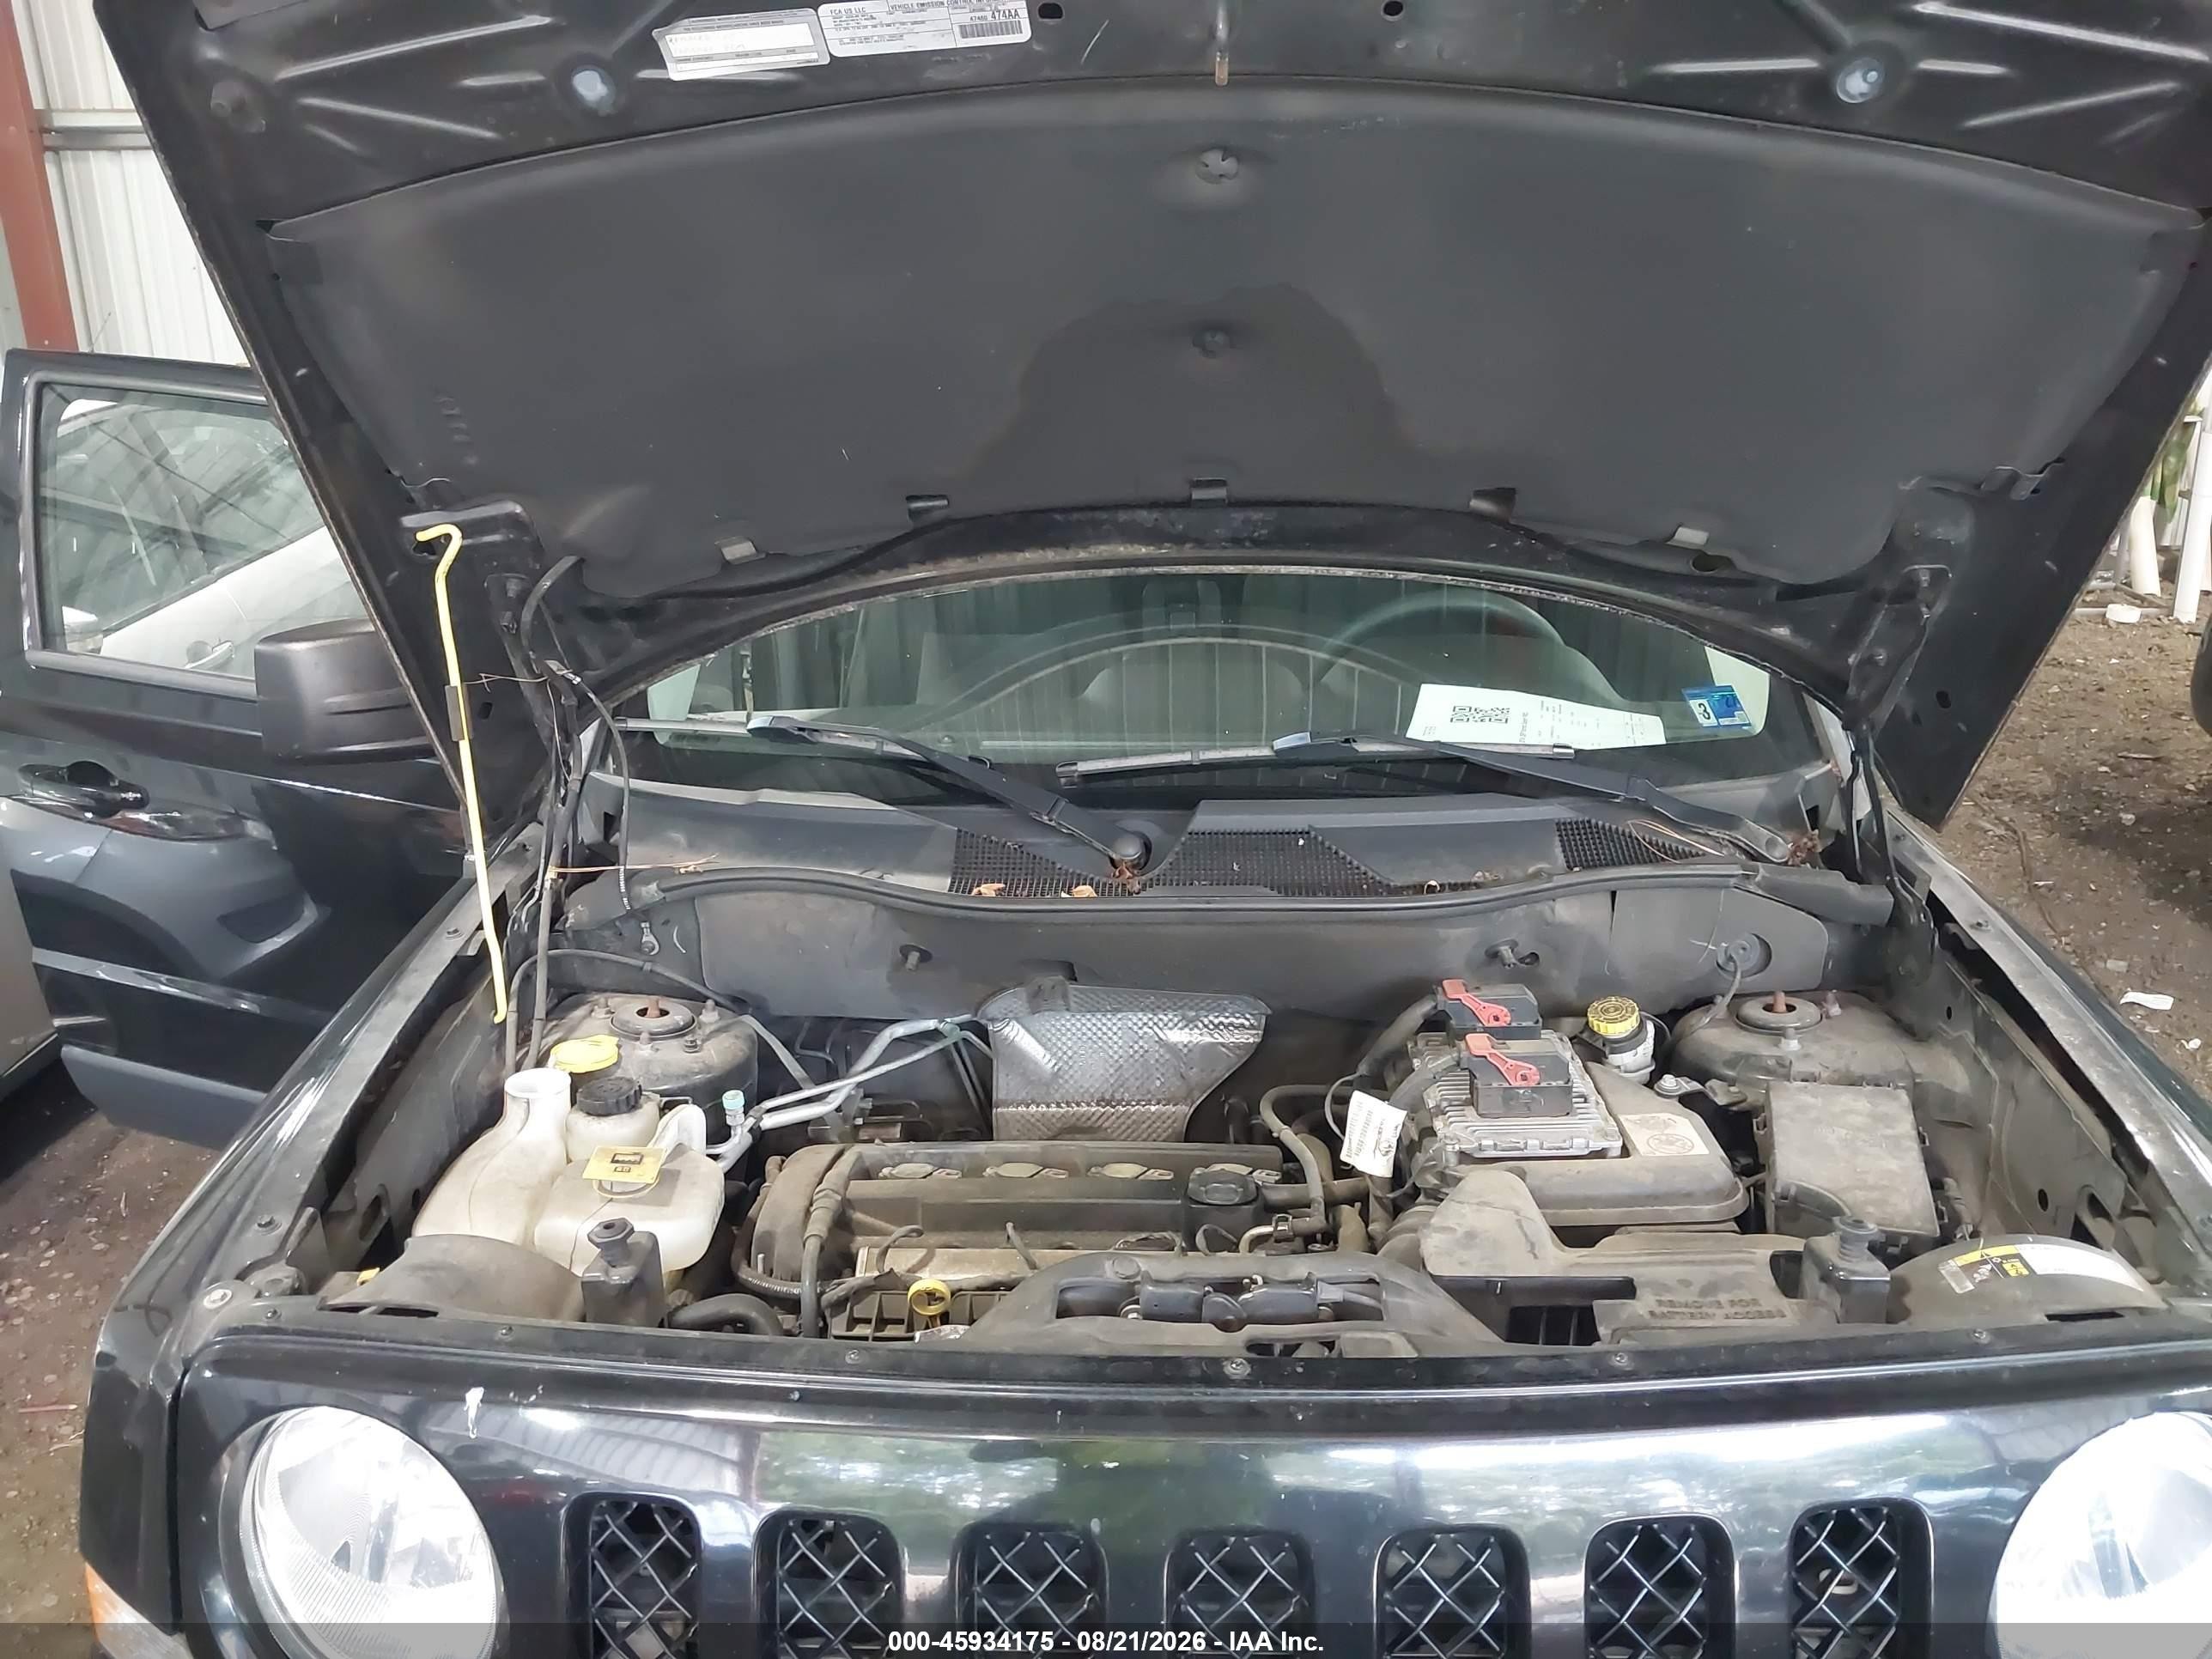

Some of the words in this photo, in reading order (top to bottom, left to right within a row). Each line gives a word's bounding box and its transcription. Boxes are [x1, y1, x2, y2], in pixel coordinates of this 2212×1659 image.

[991, 9, 1020, 21] 474AA
[1698, 702, 1711, 720] 3
[1728, 1297, 1763, 1309] FOR
